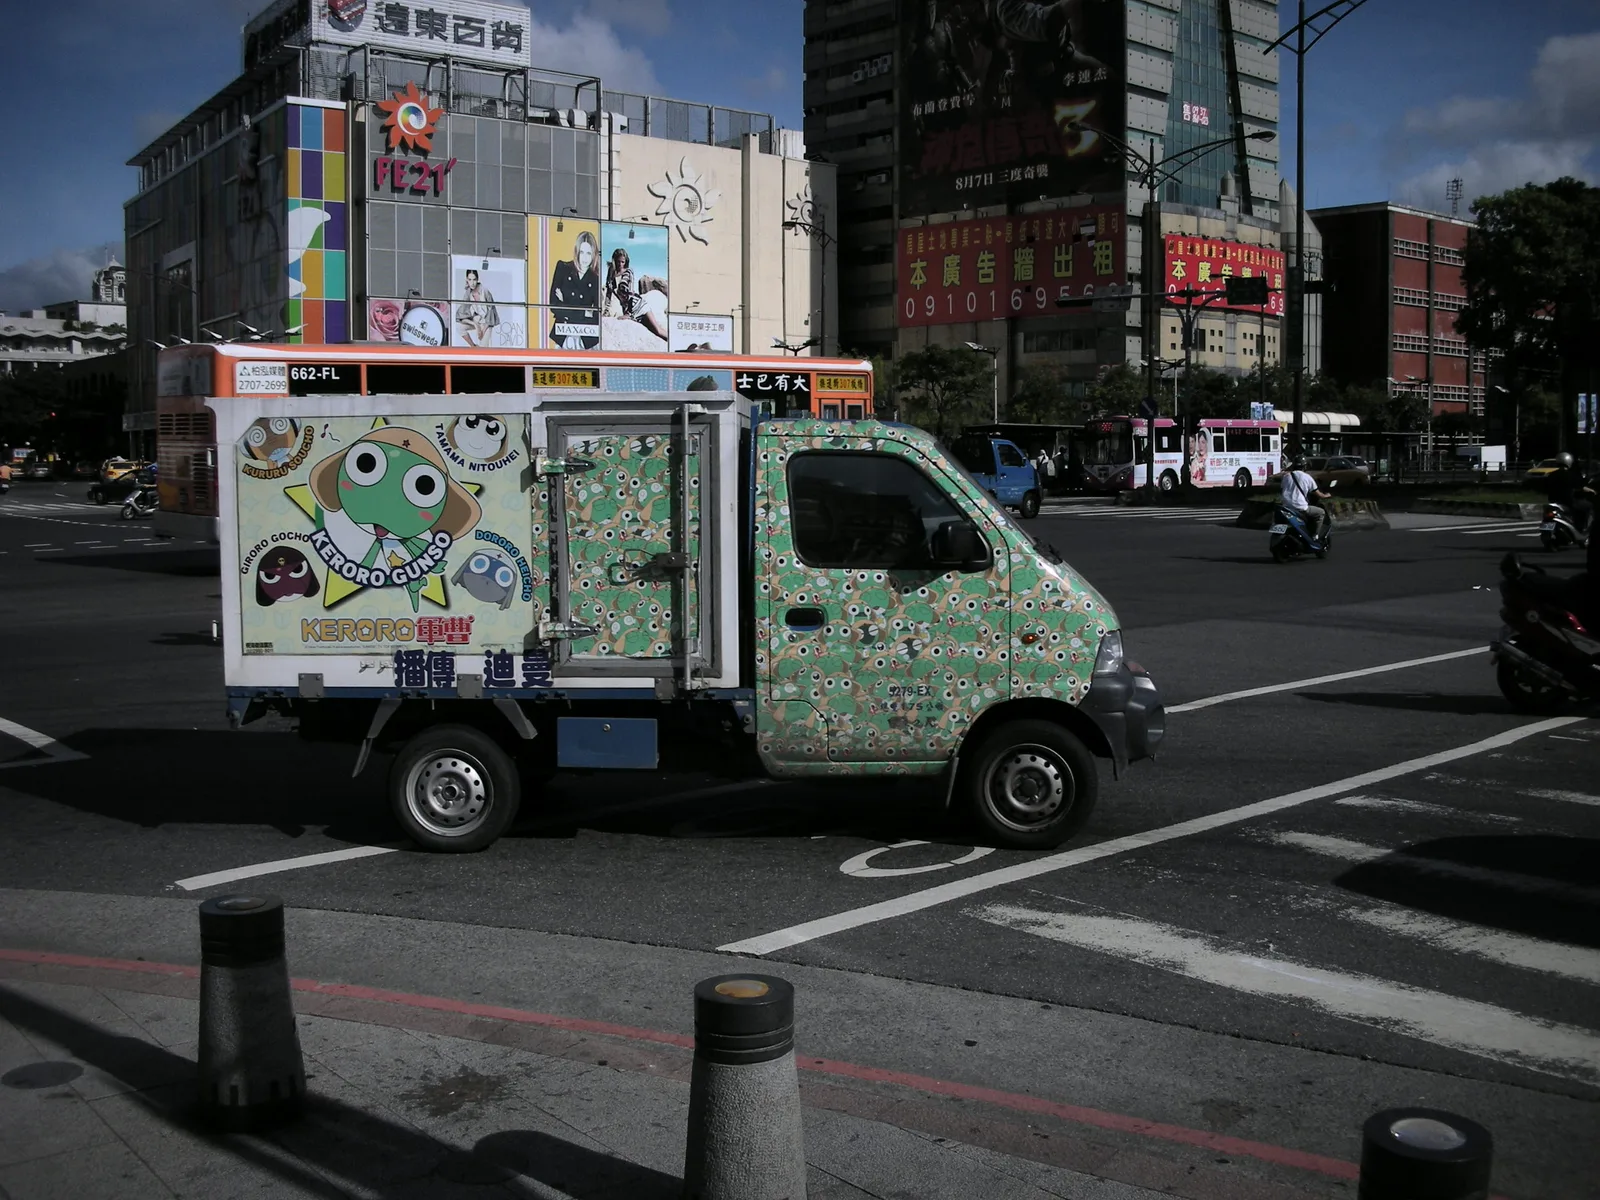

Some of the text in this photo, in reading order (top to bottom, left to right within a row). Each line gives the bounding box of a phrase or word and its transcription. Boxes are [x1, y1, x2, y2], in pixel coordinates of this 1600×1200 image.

[374, 2, 523, 53] 遠東百貨
[1063, 67, 1106, 87] 李連杰
[955, 172, 993, 191] 8月7日
[909, 240, 1115, 290] 本廣告牆出租
[496, 321, 524, 334] JOAN
[499, 334, 524, 346] DAVID
[238, 380, 287, 391] 2707-2699
[290, 366, 341, 381] 662-FL
[242, 425, 315, 480] KURURU SOUCHO
[435, 423, 521, 473] TAMAMA NITOUHEI
[240, 531, 311, 575] GIRORO GOCHO
[309, 527, 453, 588] KERORO GUNSO
[475, 529, 532, 602] DORORO HEICHO
